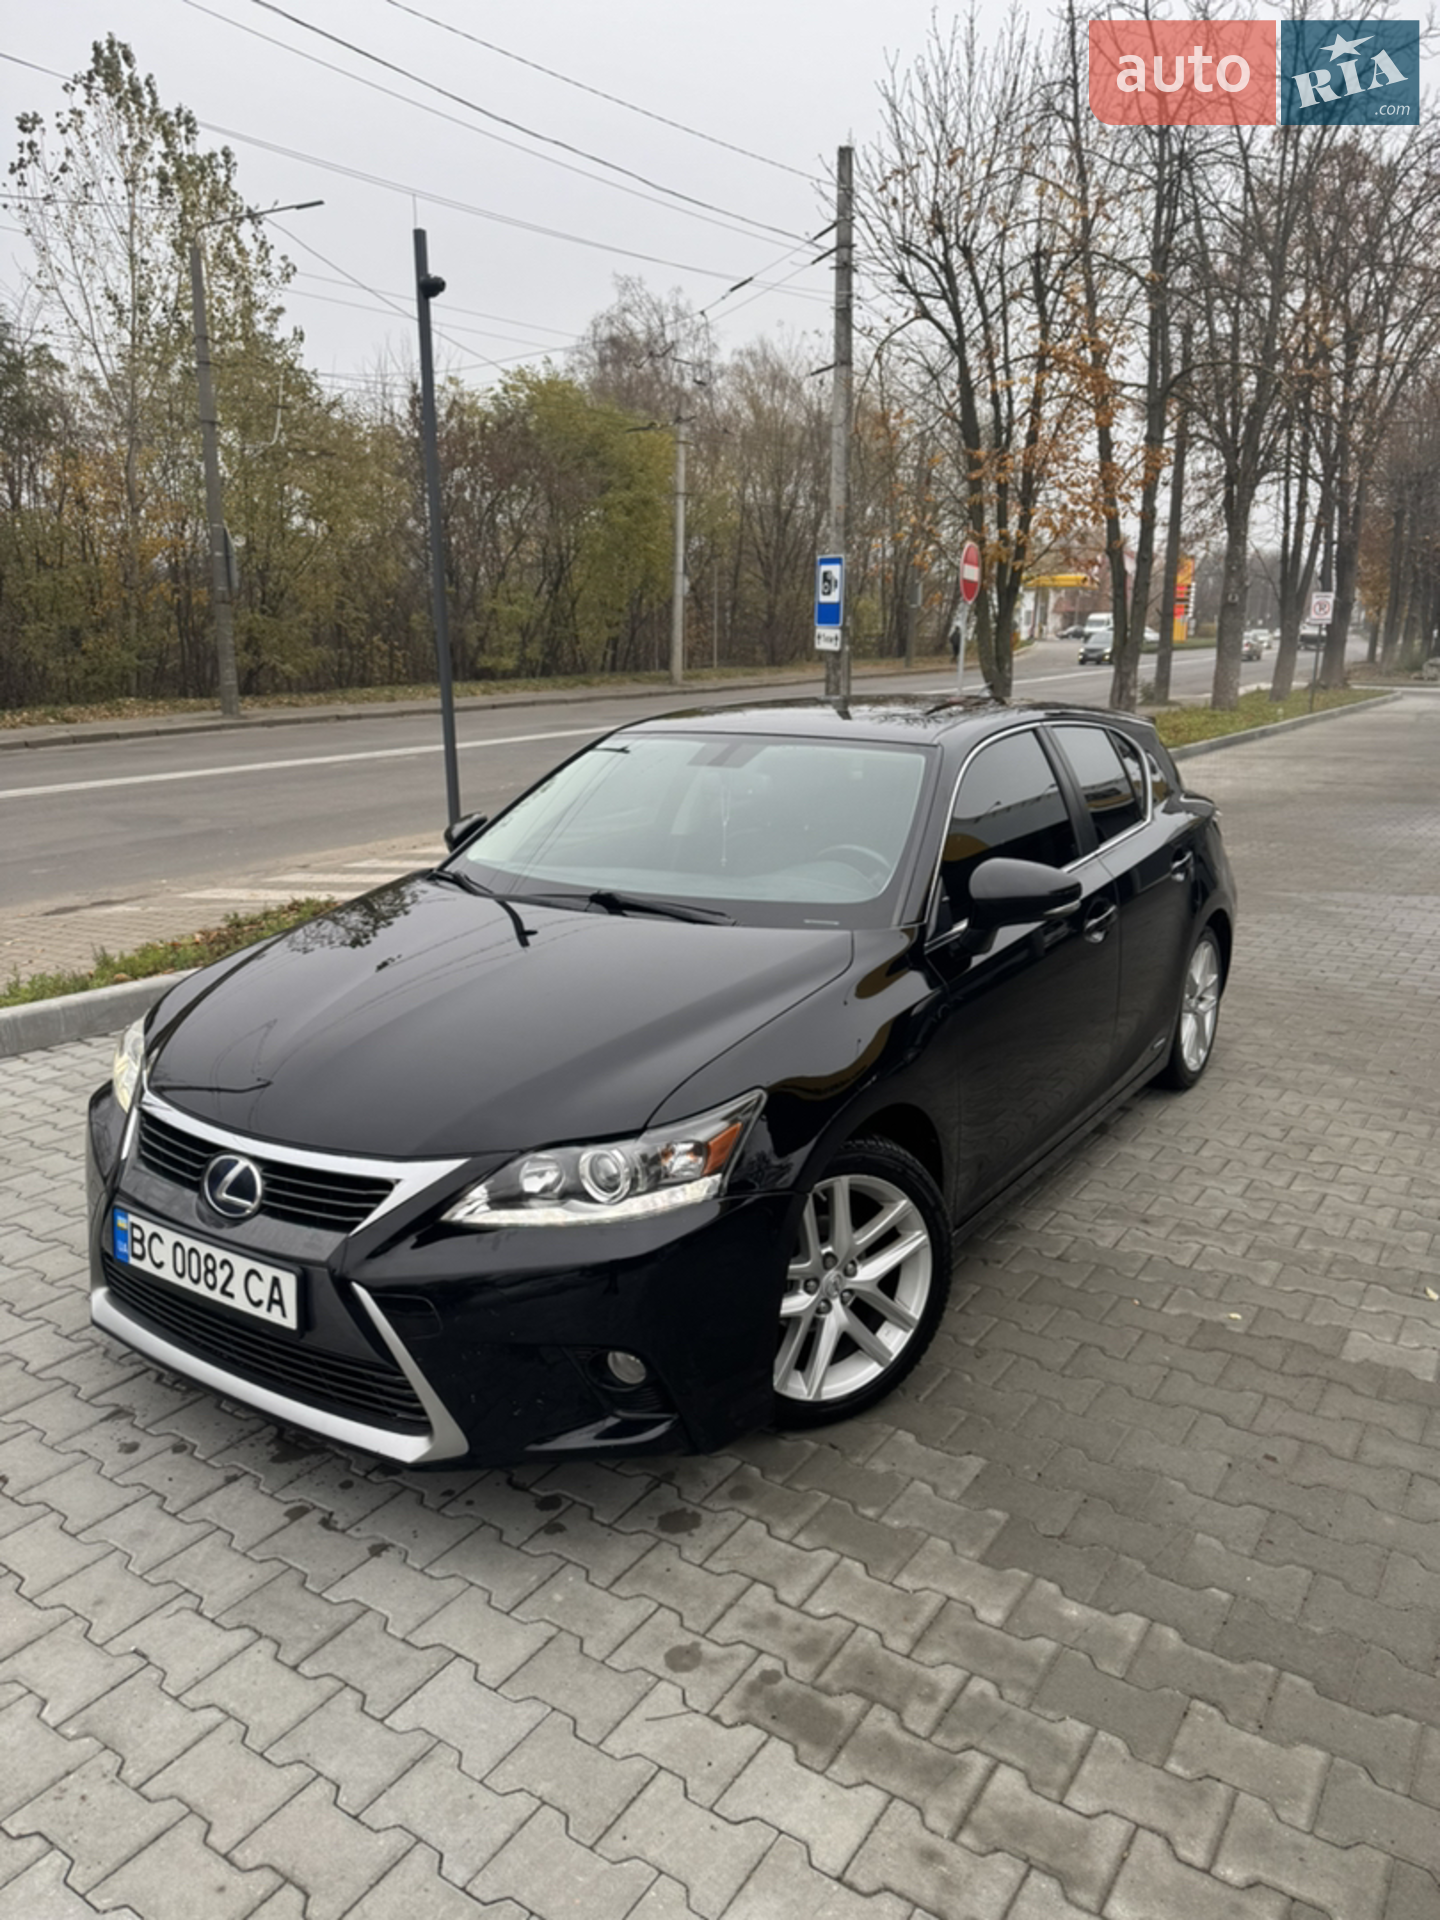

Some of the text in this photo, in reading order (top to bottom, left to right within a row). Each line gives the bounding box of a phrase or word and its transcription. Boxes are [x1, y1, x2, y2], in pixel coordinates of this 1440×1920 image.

[129, 1221, 288, 1319] BC 0082 CA
